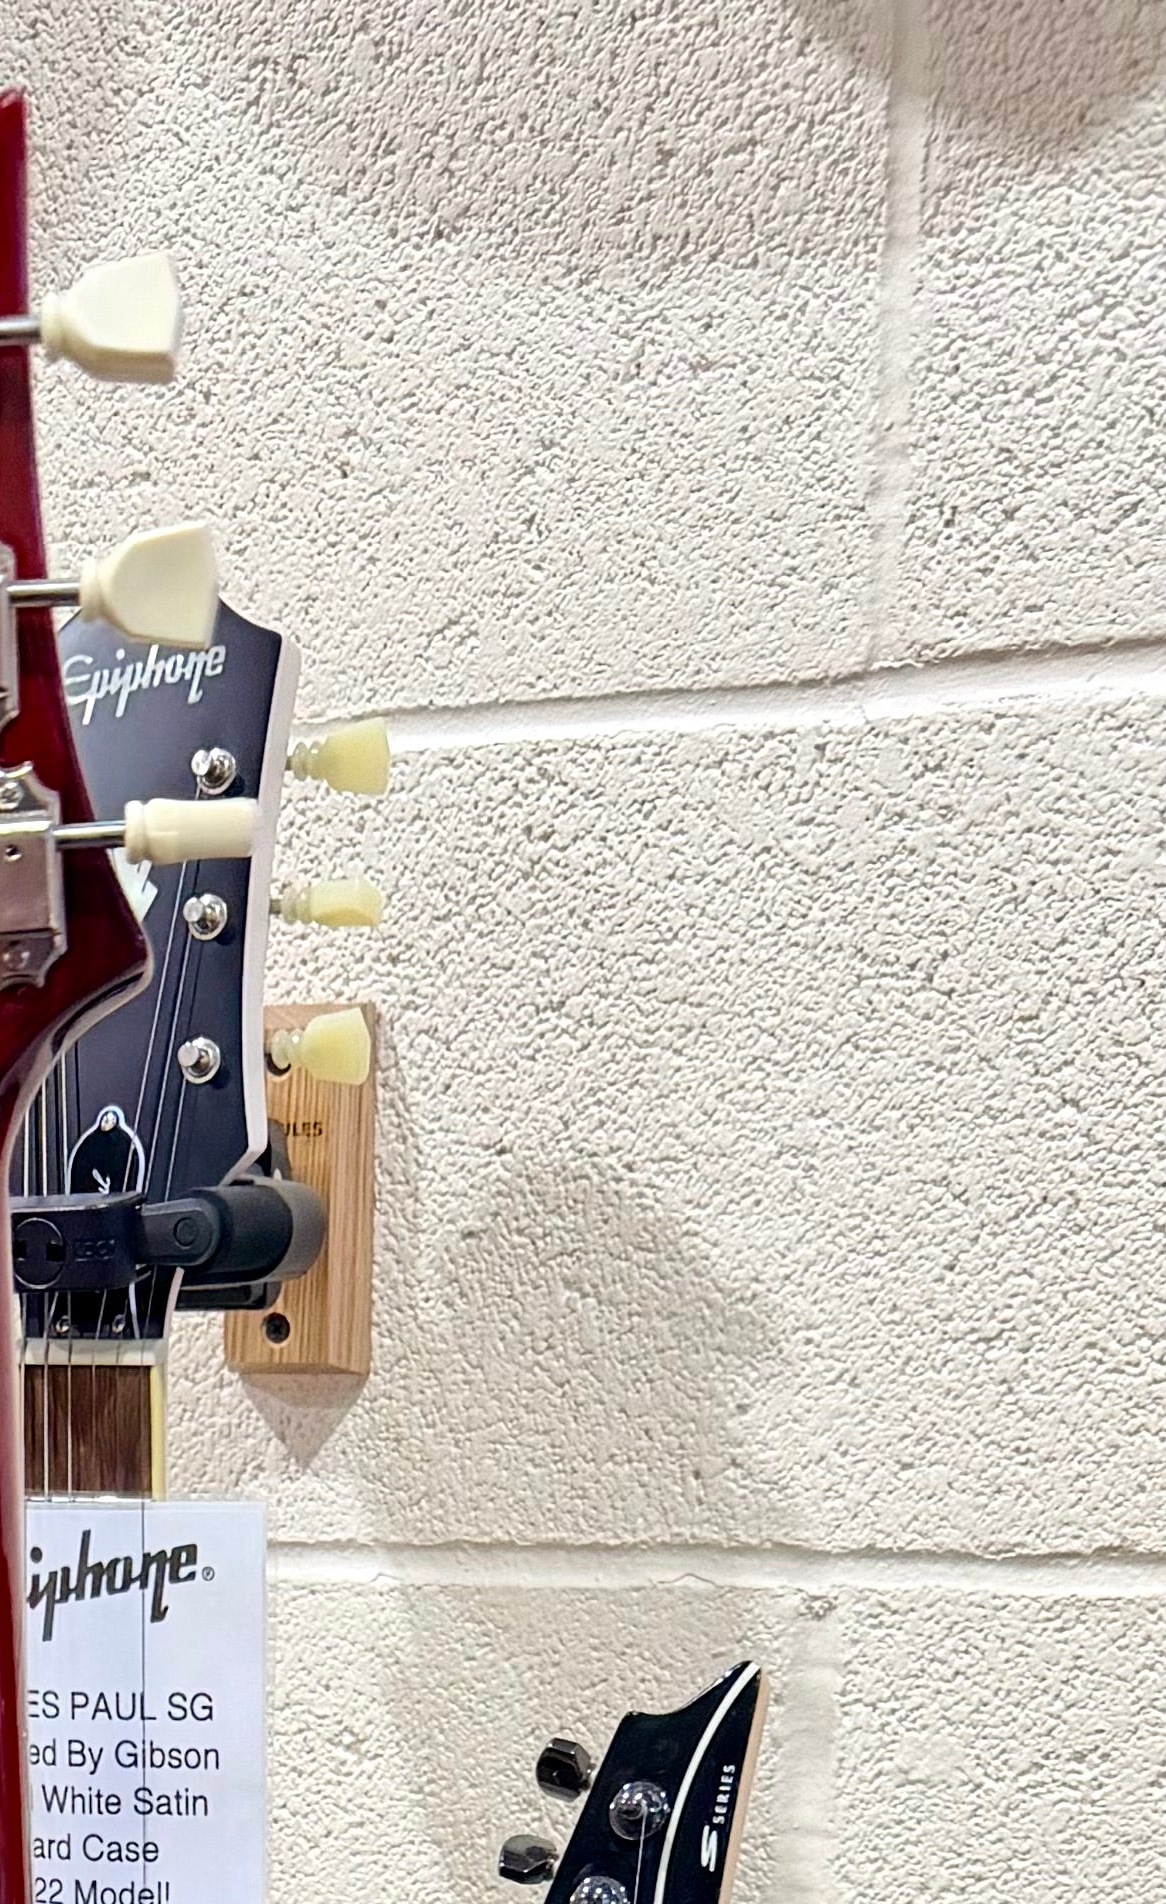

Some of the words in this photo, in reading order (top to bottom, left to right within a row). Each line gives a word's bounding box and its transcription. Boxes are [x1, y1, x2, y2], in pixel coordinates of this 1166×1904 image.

[63, 644, 227, 726] Epiphone
[27, 1529, 198, 1642] iphone
[71, 1691, 157, 1721] PAUL
[168, 1692, 213, 1721] SG
[68, 1739, 103, 1775] By
[115, 1739, 220, 1770] Gibson
[41, 1784, 121, 1816] White
[134, 1787, 209, 1817] Satin
[712, 1764, 736, 1825] SERIES
[34, 1833, 71, 1861] ard
[83, 1833, 159, 1863] Case
